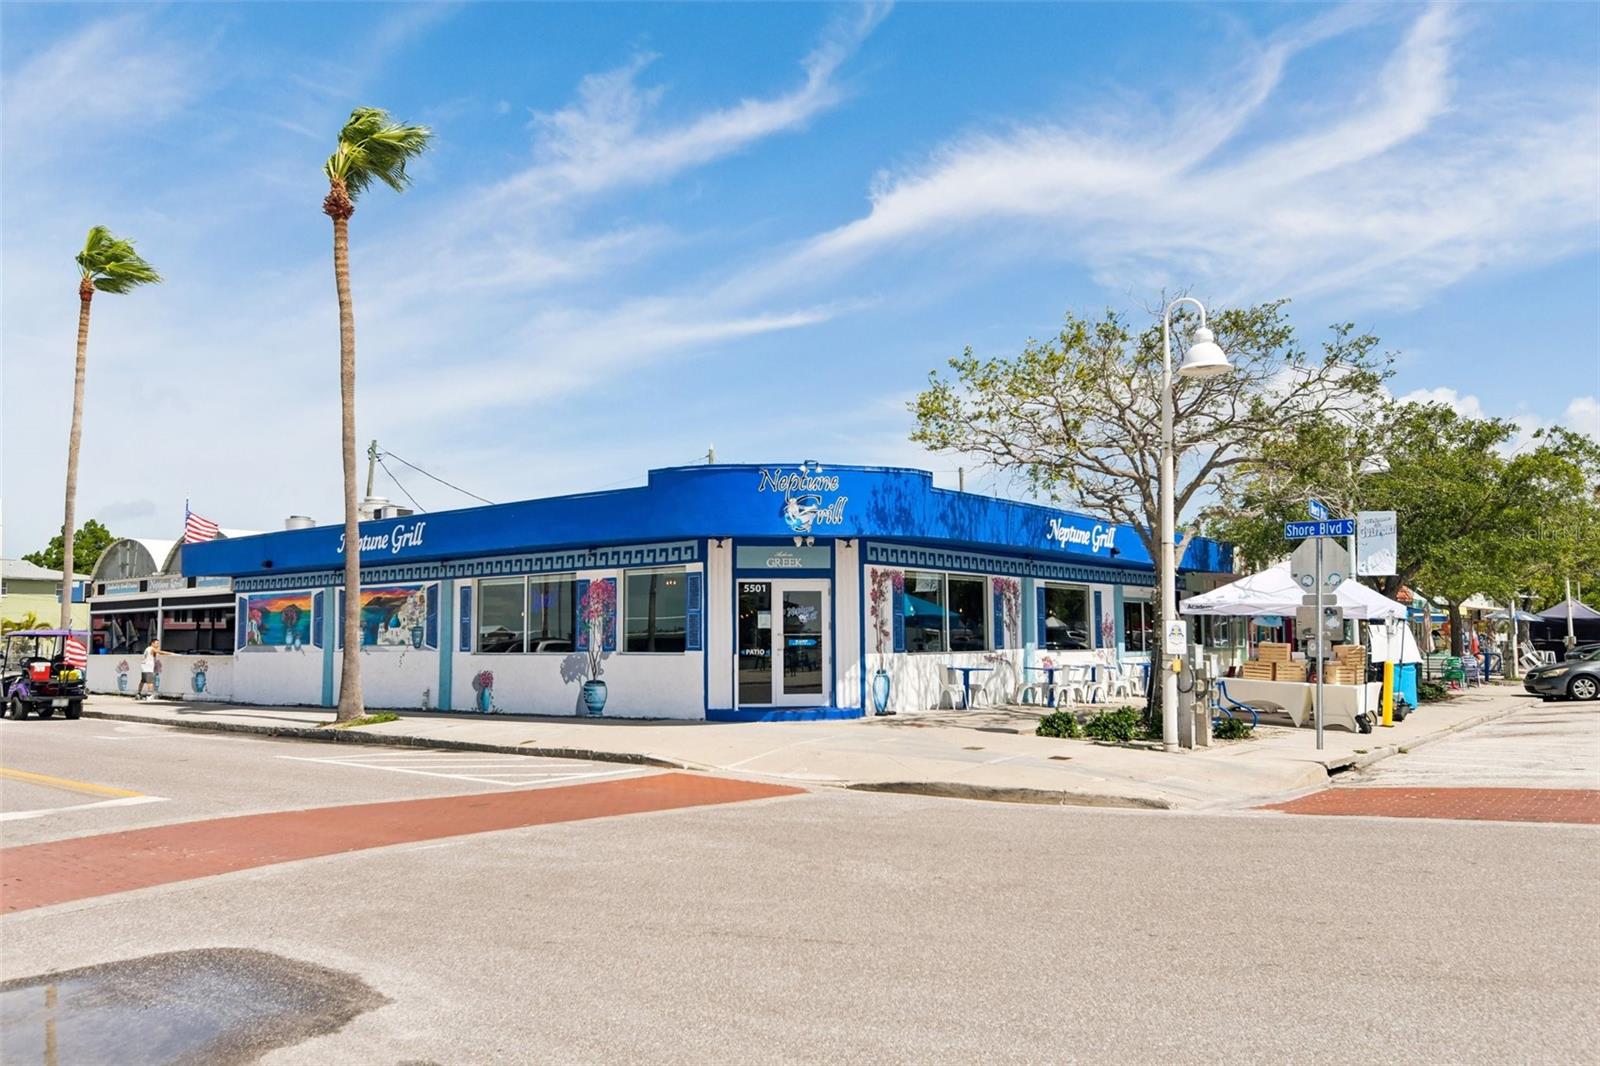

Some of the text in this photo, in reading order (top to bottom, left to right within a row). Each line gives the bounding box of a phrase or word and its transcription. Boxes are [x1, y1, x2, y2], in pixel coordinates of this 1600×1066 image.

[758, 468, 840, 504] Neptune
[392, 522, 426, 554] Grill
[1046, 518, 1116, 552] Neptune Grill
[1286, 524, 1315, 537] Shore
[1320, 522, 1342, 535] Blvd
[1346, 521, 1353, 533] S
[766, 558, 802, 568] GREEK
[743, 584, 767, 593] 5501
